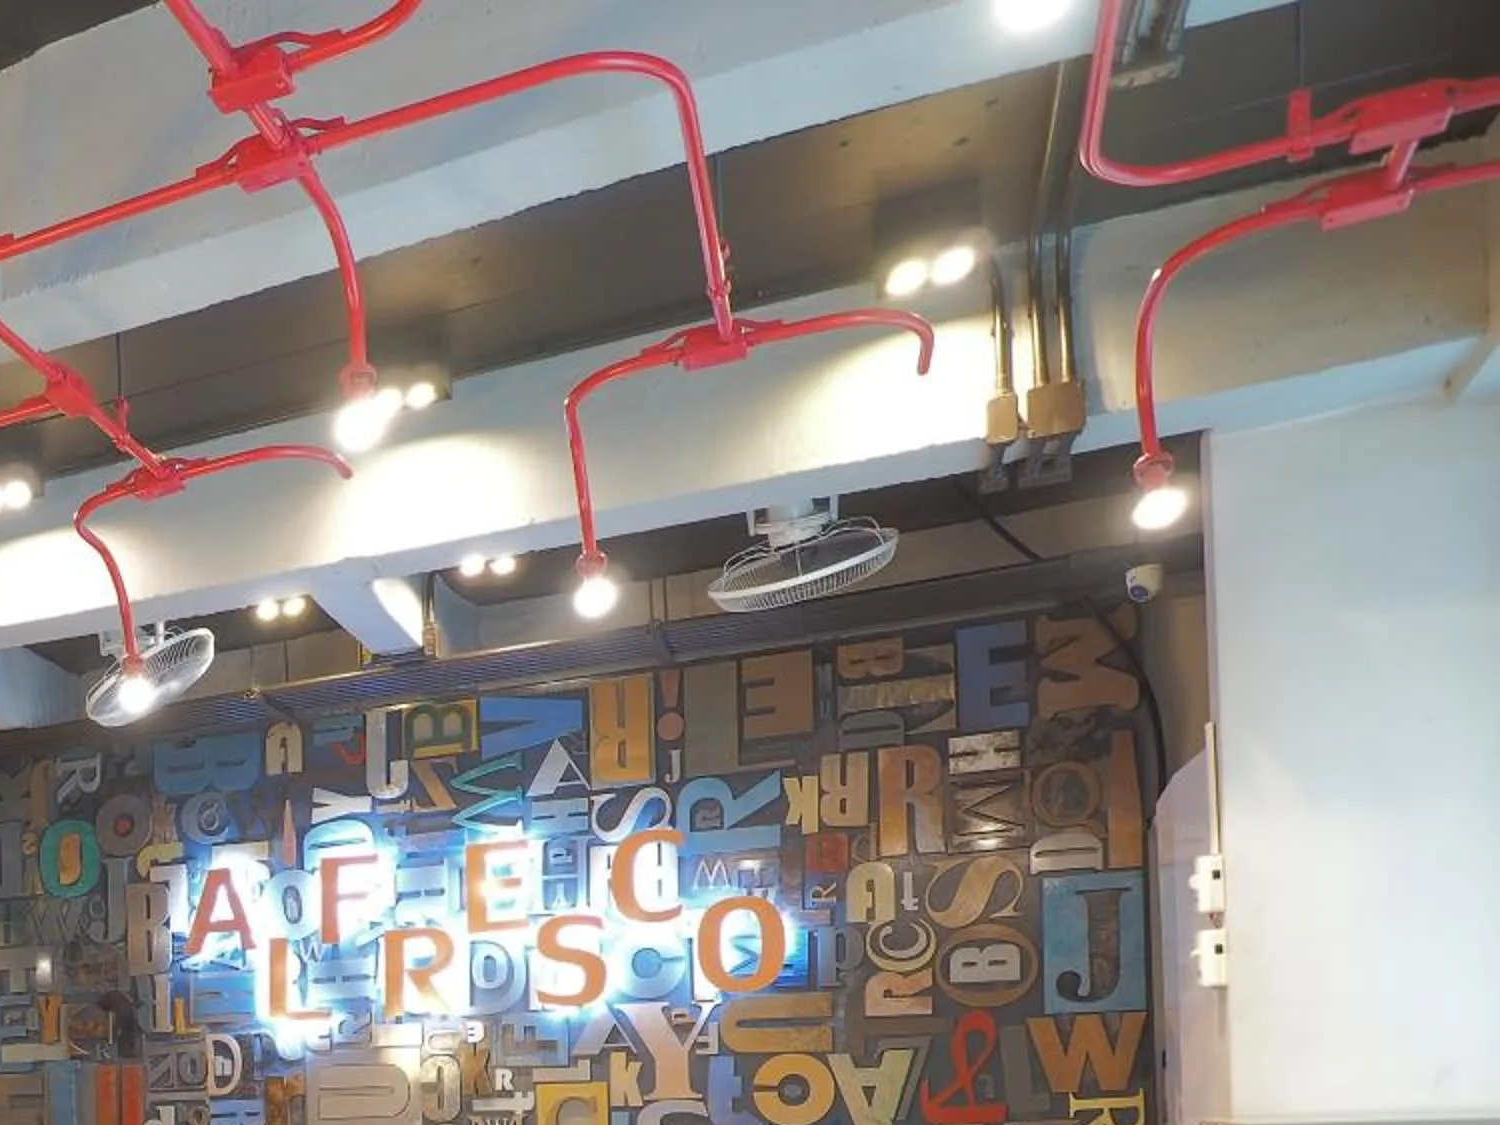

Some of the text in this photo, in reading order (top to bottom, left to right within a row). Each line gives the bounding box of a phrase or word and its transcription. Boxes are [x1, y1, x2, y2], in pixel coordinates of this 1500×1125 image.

[878, 745, 946, 857] R
[1056, 887, 1134, 1003] J
[614, 1001, 723, 1099] Y
